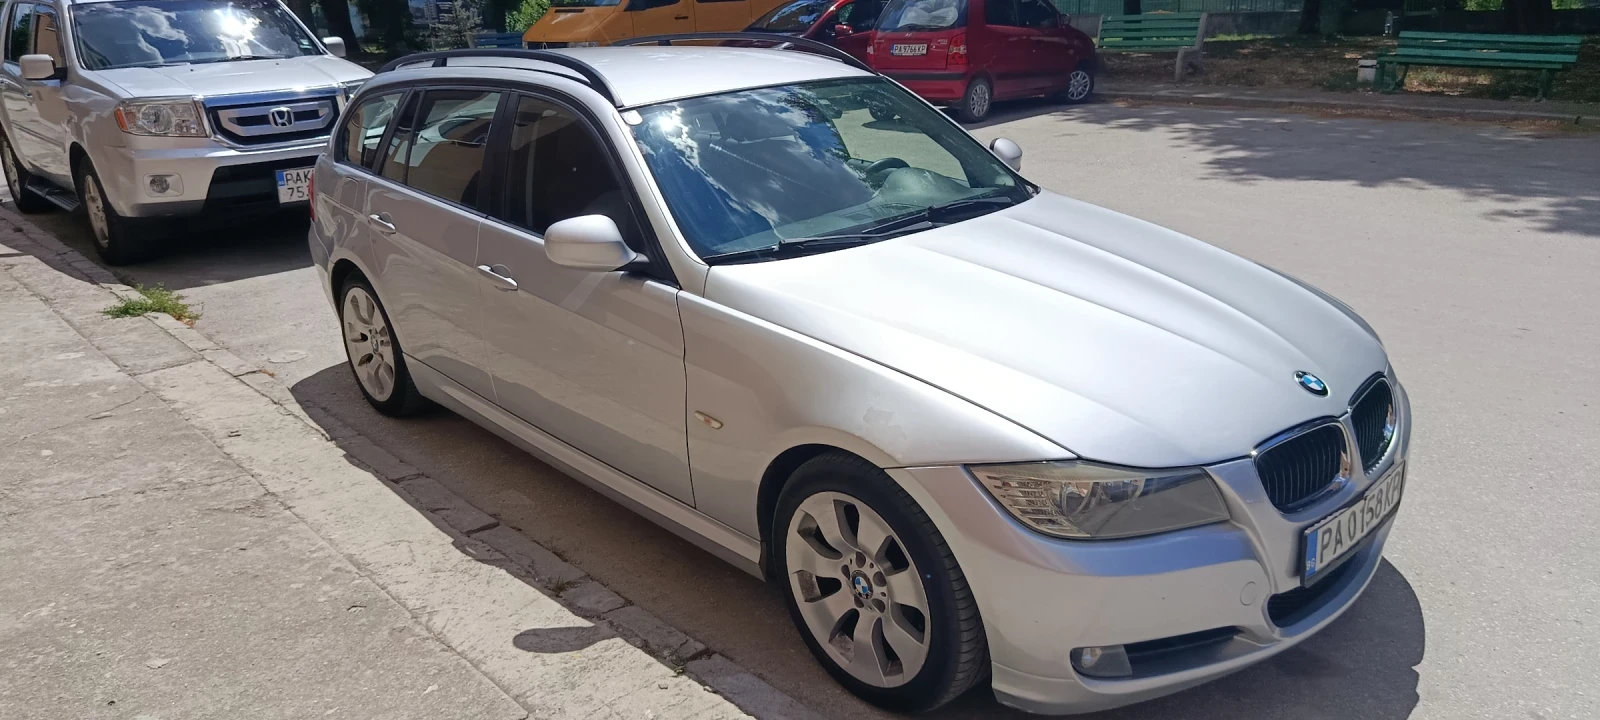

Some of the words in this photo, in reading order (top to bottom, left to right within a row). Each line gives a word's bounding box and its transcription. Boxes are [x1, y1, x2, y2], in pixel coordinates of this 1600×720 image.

[917, 45, 926, 53] KP
[1320, 519, 1343, 564] PA
[1347, 488, 1383, 543] 0158
[1383, 469, 1402, 512] KP
[1306, 557, 1316, 570] BG
